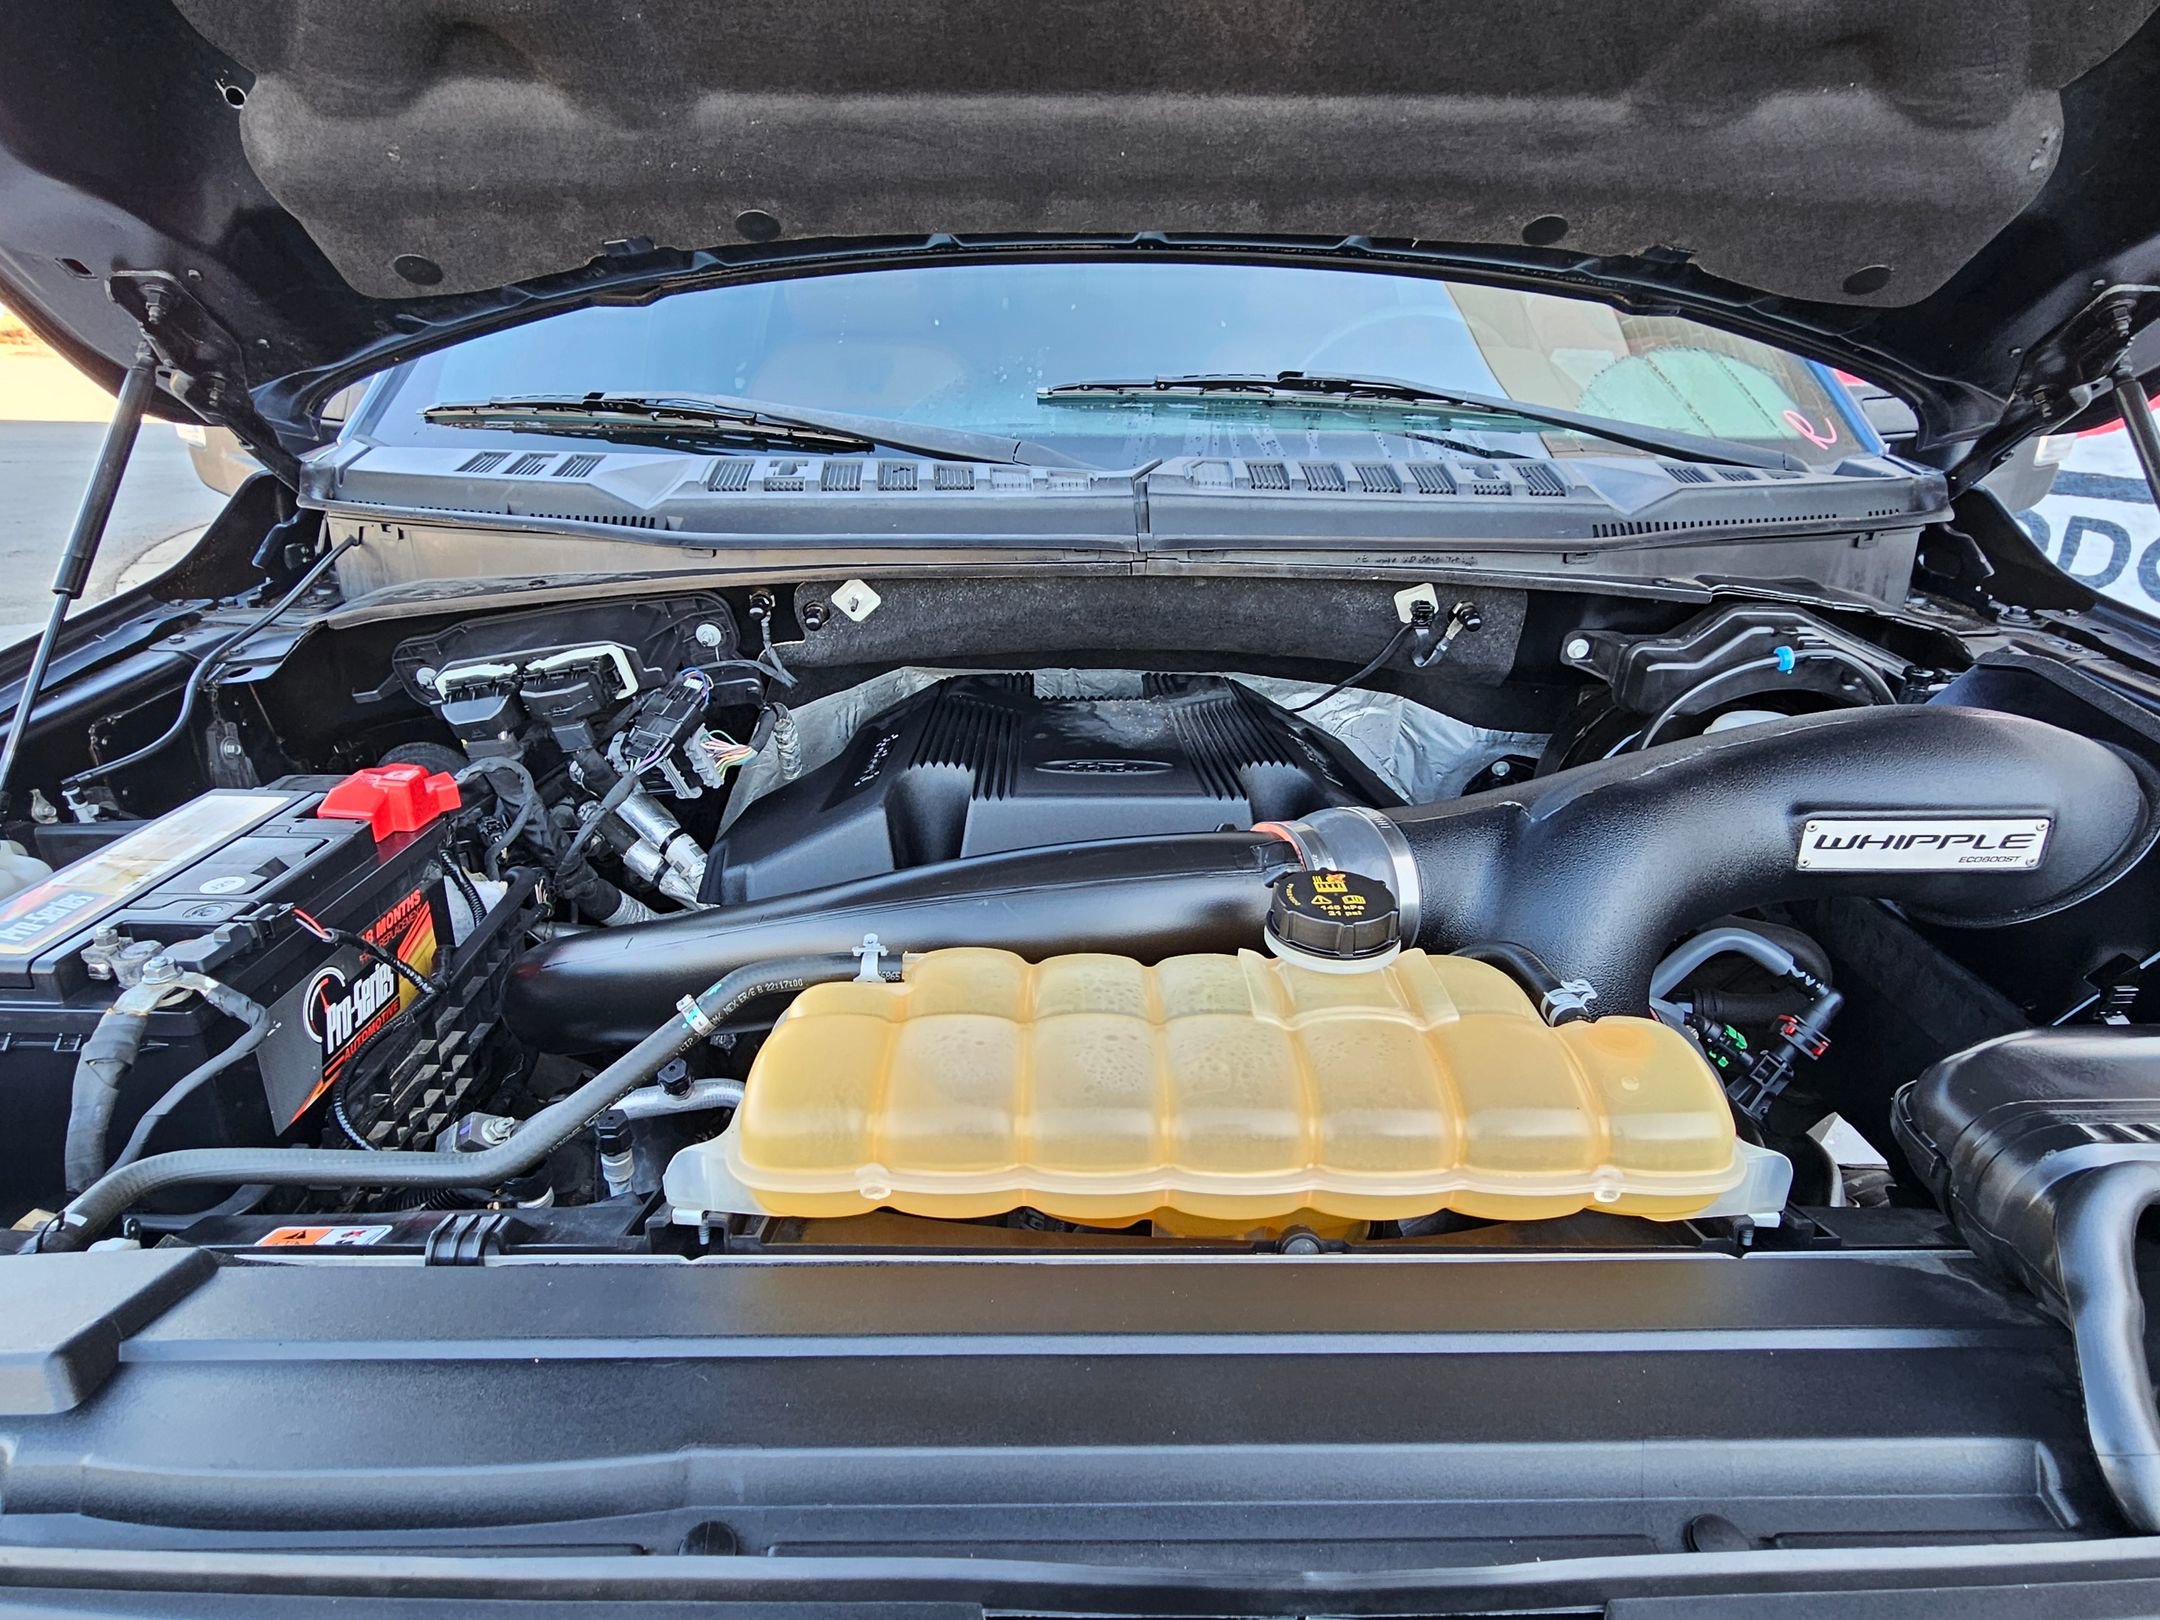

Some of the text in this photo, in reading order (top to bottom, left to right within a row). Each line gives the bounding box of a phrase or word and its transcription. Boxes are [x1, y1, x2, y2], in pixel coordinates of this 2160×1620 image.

[1813, 833, 2037, 851] WHIPPLE
[375, 888, 421, 940] MONTHS
[326, 963, 395, 1055] Pro-Series
[344, 1000, 400, 1061] AUTOMOTIVE
